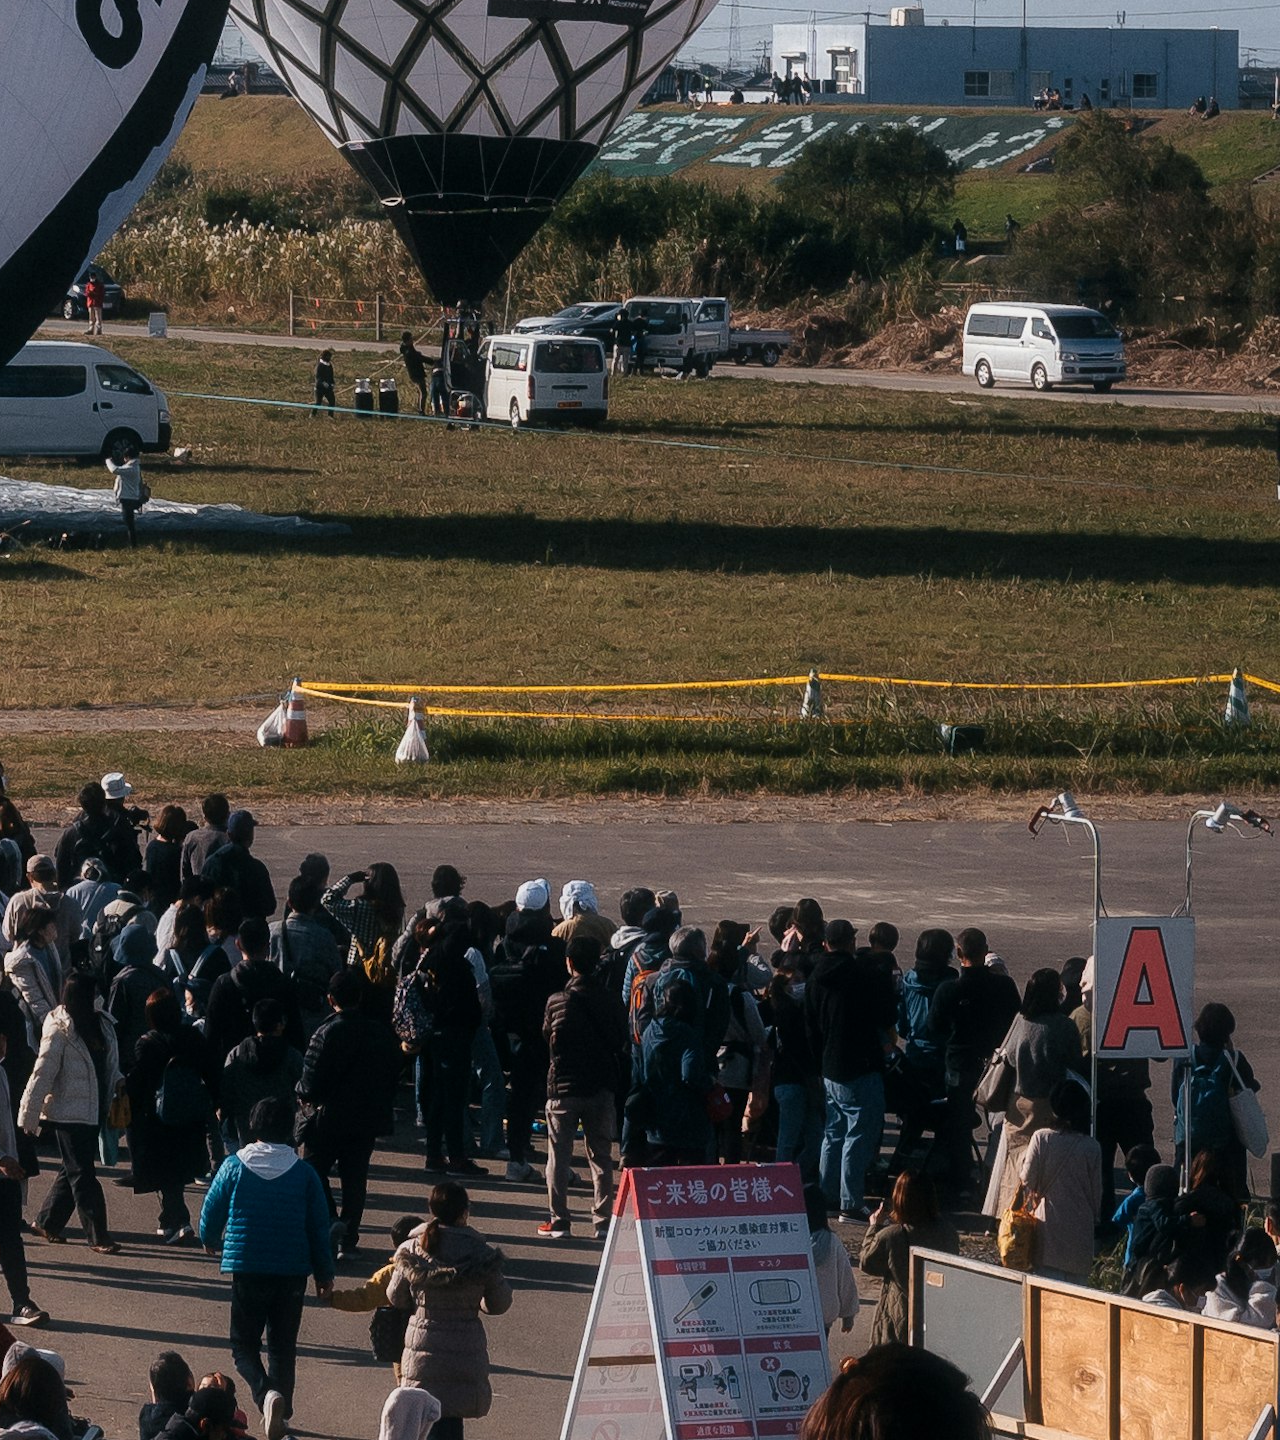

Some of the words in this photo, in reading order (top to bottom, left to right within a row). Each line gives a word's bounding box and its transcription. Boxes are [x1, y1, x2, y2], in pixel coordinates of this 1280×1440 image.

[1099, 926, 1189, 1051] A
[646, 1176, 795, 1206] ご来場の皆様へ
[654, 1221, 800, 1239] 新型コロナウイルス感染症対策に
[697, 1239, 762, 1253] ご協力ください
[758, 1258, 782, 1268] マスク
